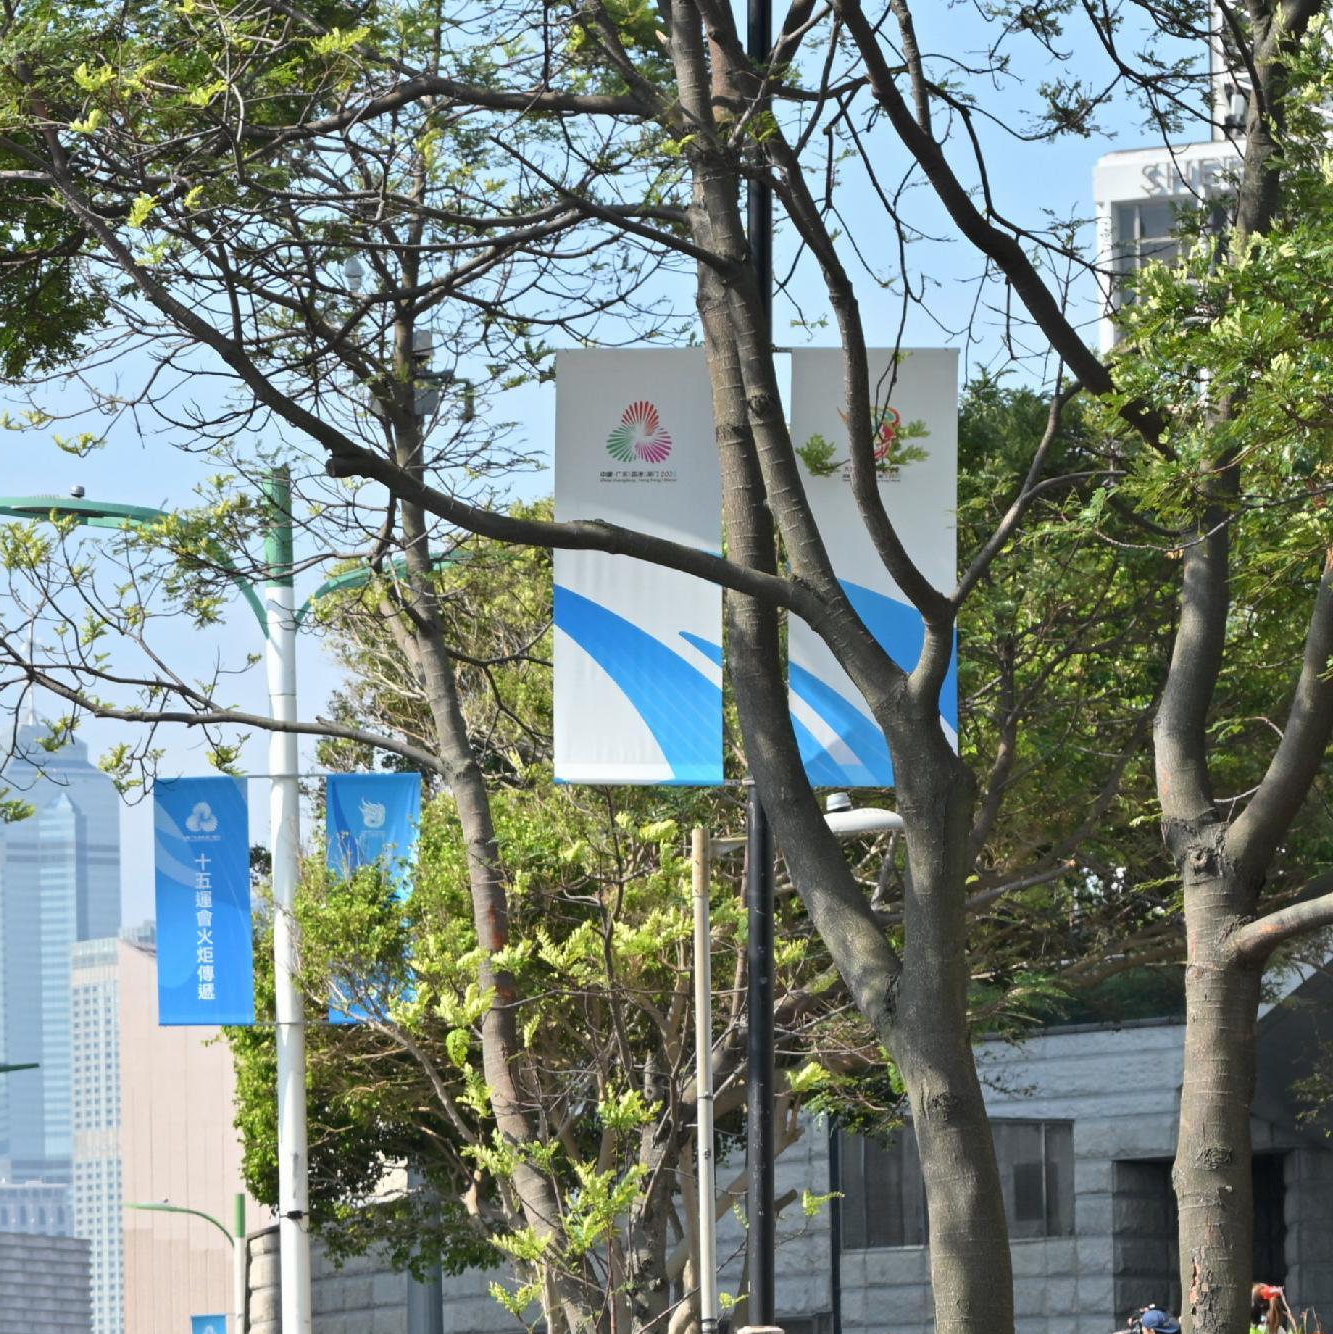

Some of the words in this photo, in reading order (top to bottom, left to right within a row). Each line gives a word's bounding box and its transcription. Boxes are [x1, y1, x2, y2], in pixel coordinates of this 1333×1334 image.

[194, 853, 216, 1000] 十五運會火炬傳遞
